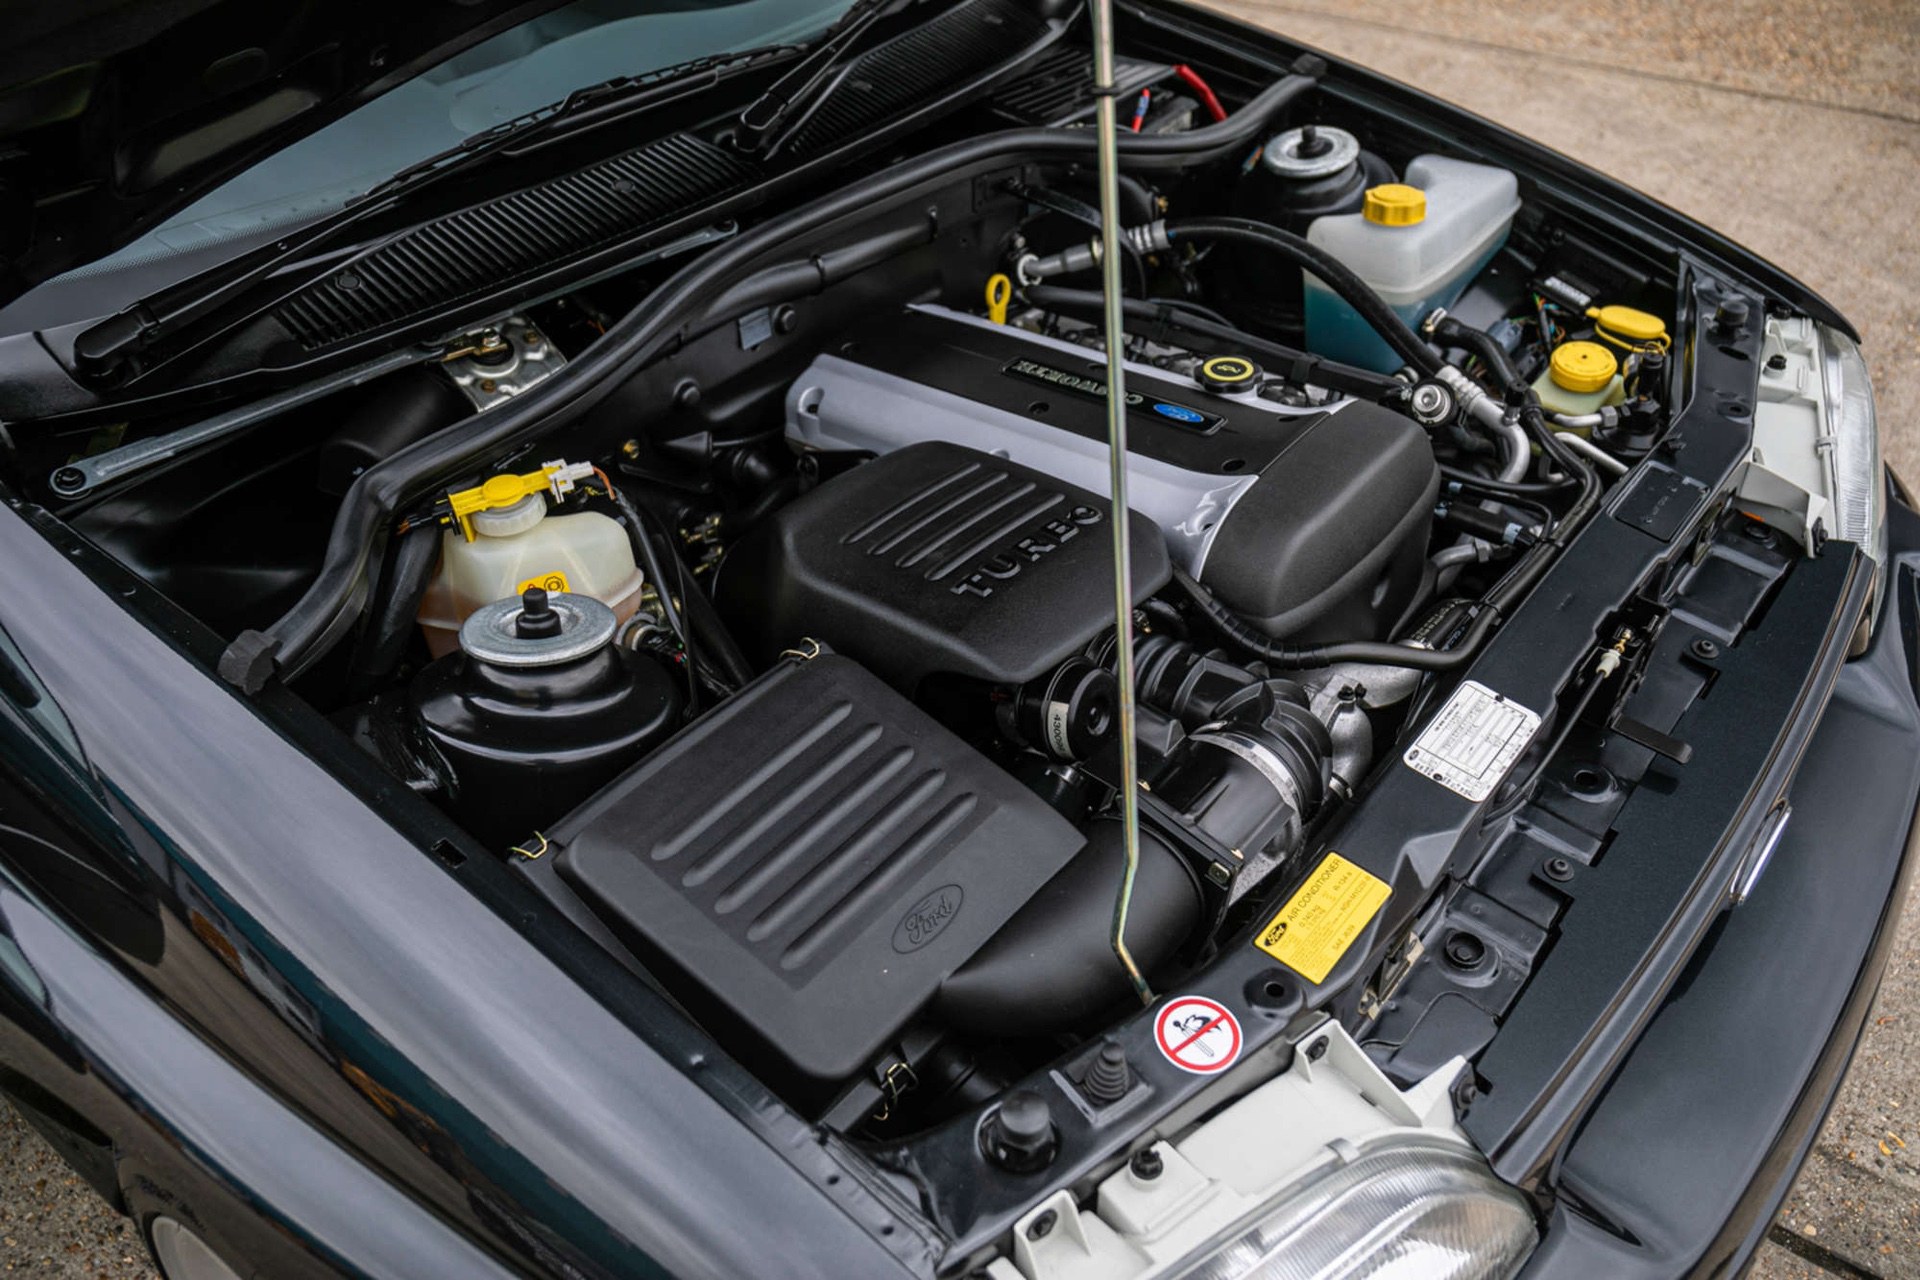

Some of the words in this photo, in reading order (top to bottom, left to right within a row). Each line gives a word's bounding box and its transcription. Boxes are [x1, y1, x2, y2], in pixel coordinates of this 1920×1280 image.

[950, 505, 1104, 597] TURBO
[1287, 907, 1300, 922] AIR
[1298, 859, 1342, 909] CONDITIONER
[904, 894, 953, 946] Ford
[1265, 923, 1286, 946] Ford
